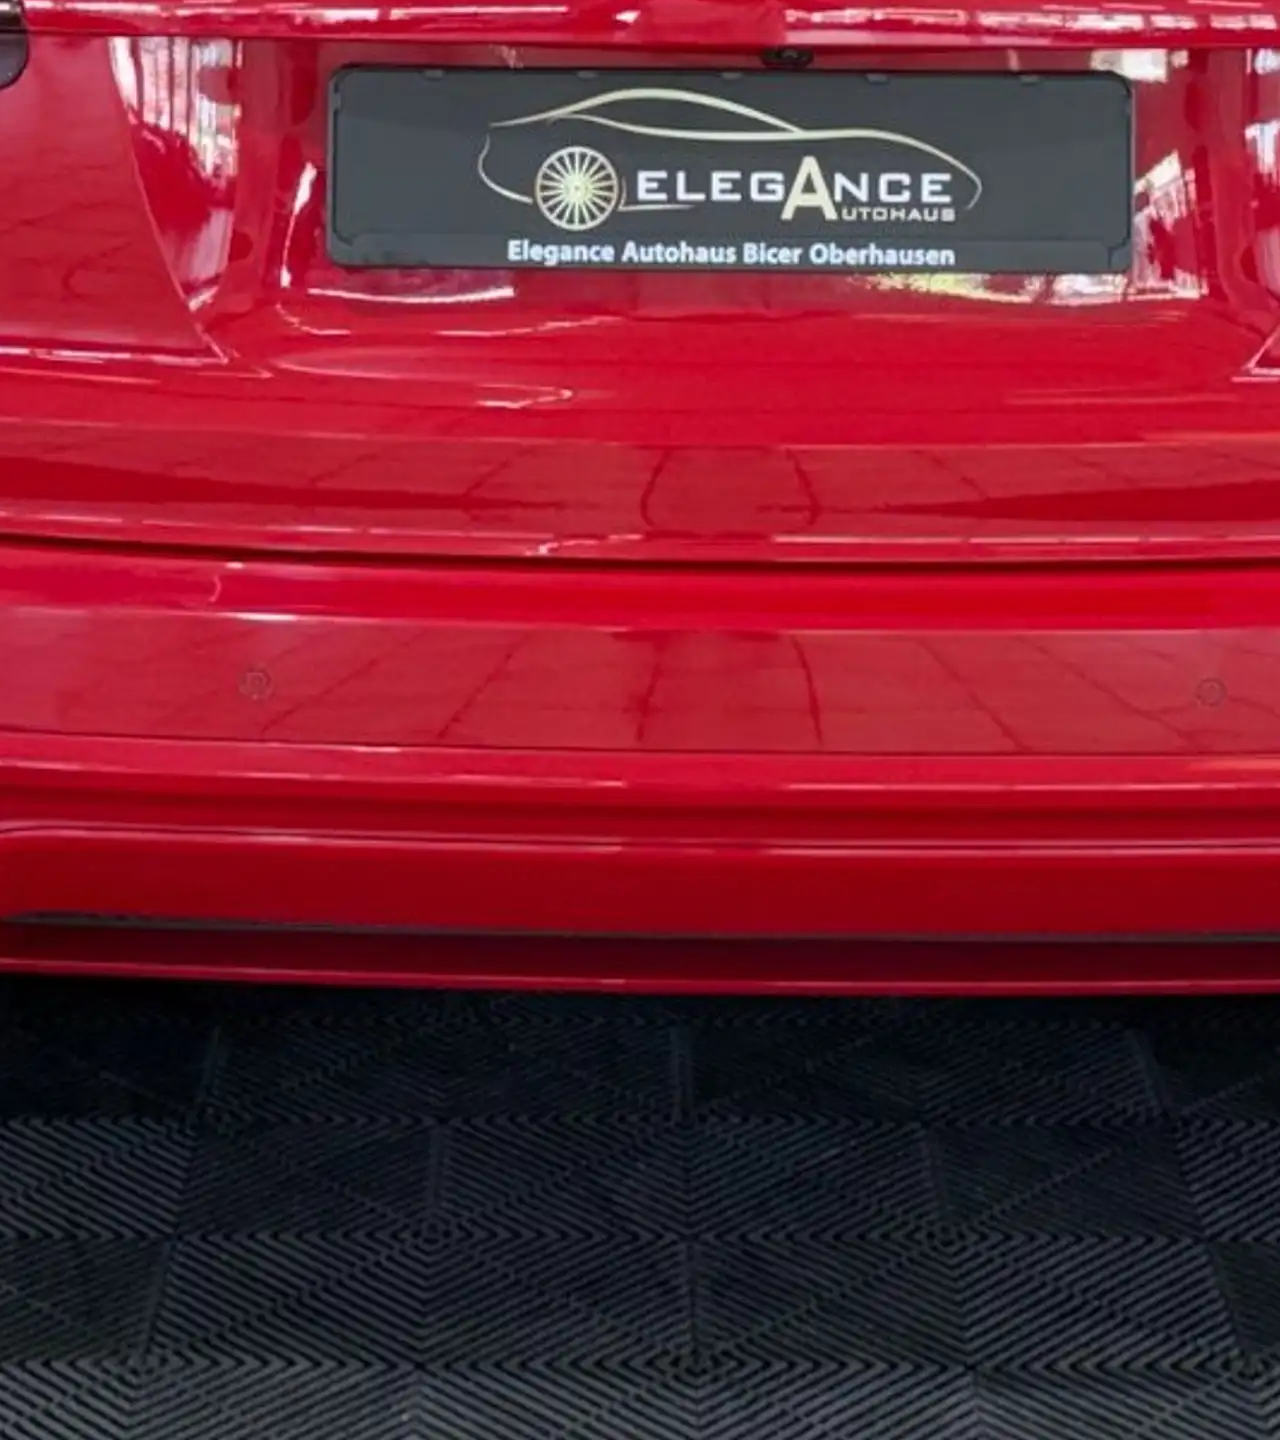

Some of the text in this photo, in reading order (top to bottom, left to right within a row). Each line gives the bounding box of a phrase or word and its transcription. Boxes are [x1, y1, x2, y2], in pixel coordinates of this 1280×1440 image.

[636, 155, 954, 221] ELEGANCE
[507, 239, 956, 267] Elegance Autohaus Bicer Oberhausen
